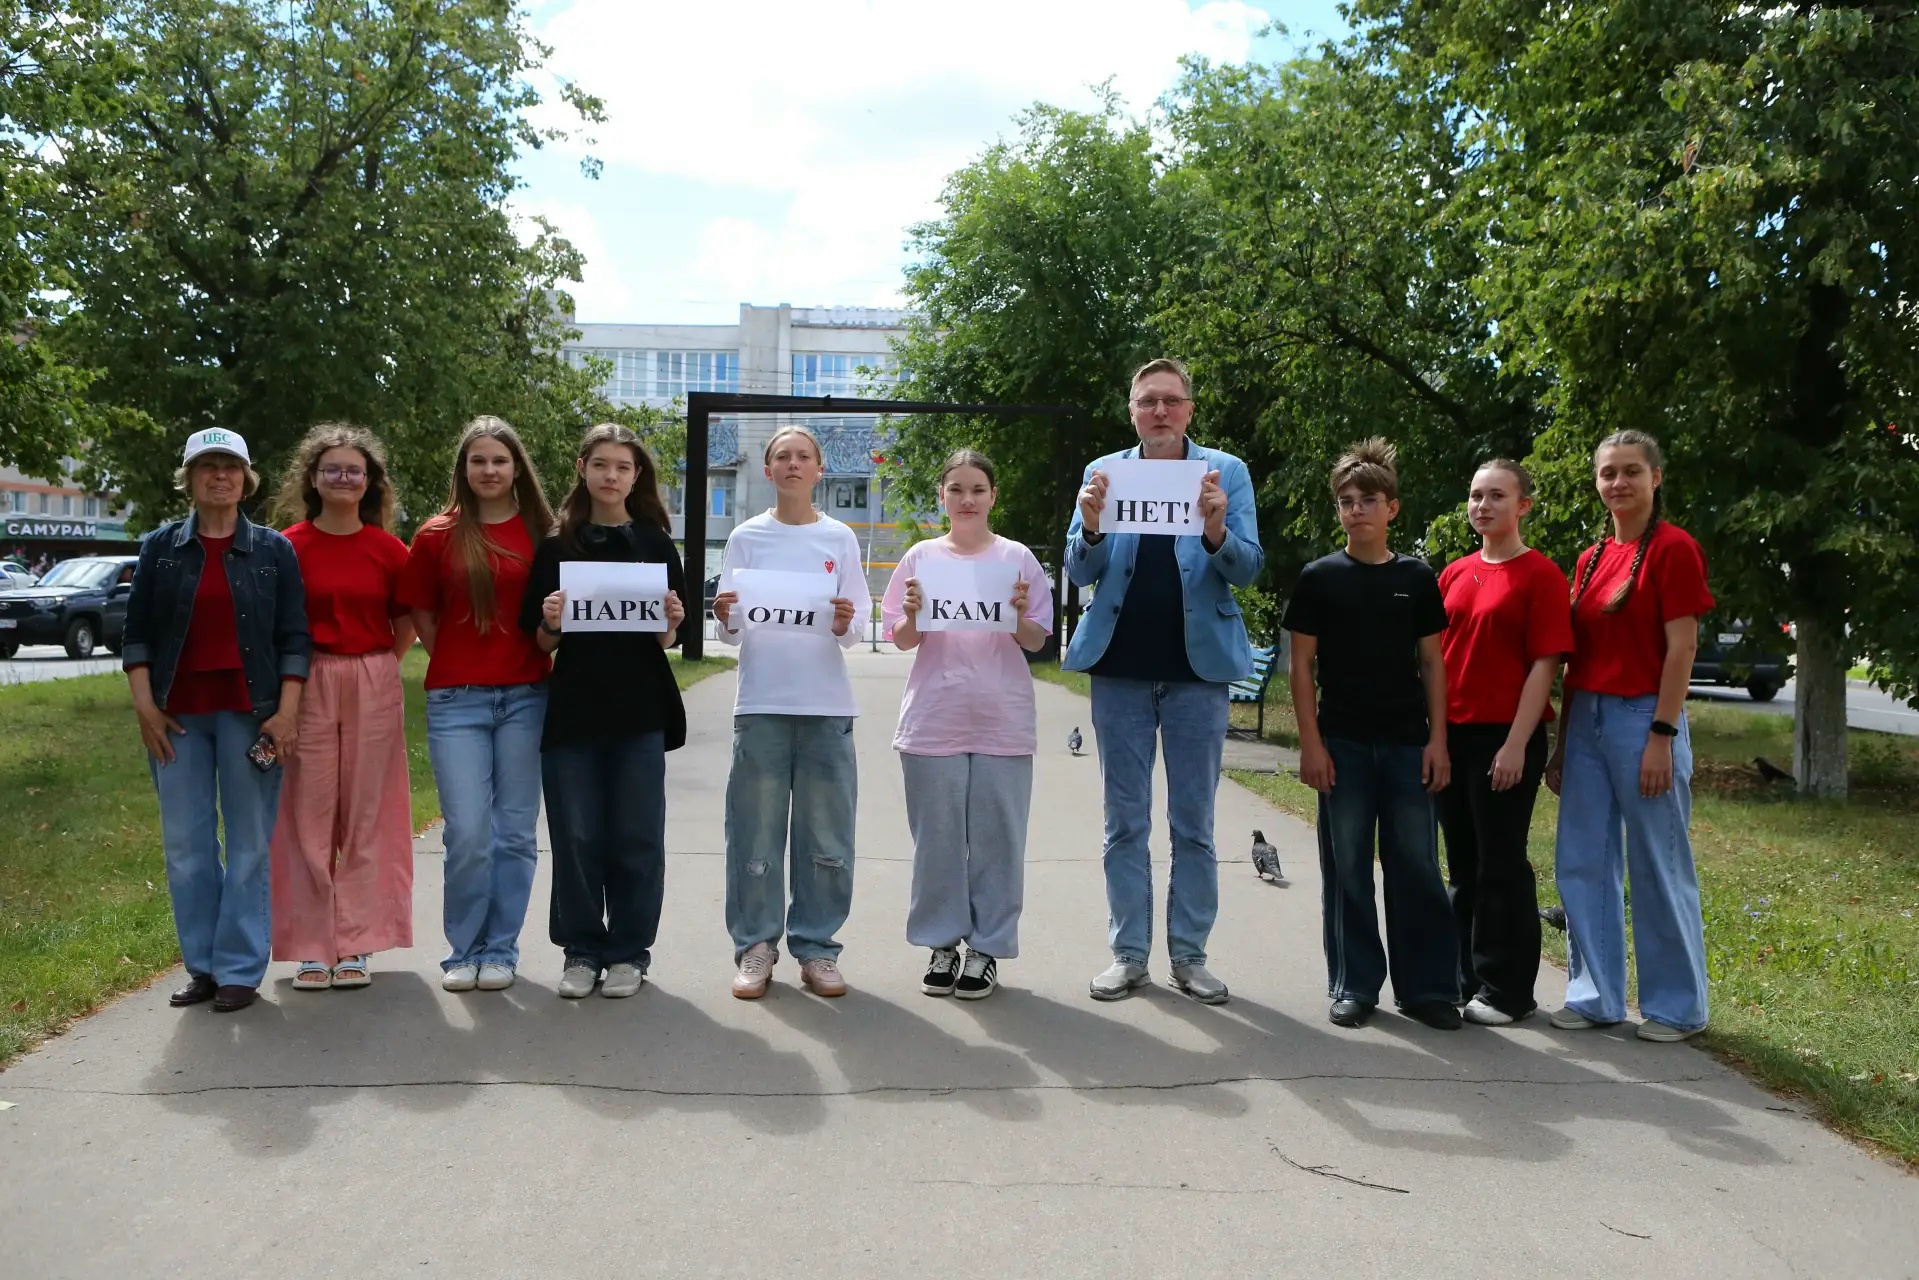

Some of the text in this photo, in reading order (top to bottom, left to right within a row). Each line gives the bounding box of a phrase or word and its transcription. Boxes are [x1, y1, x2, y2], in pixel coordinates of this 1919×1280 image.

[203, 432, 230, 445] ЦБС
[1115, 500, 1190, 524] НЕТ!
[7, 521, 96, 536] САМУРАЙ
[571, 600, 660, 620] НАРК
[748, 606, 817, 626] ОТИ
[930, 599, 1003, 622] КАМ
